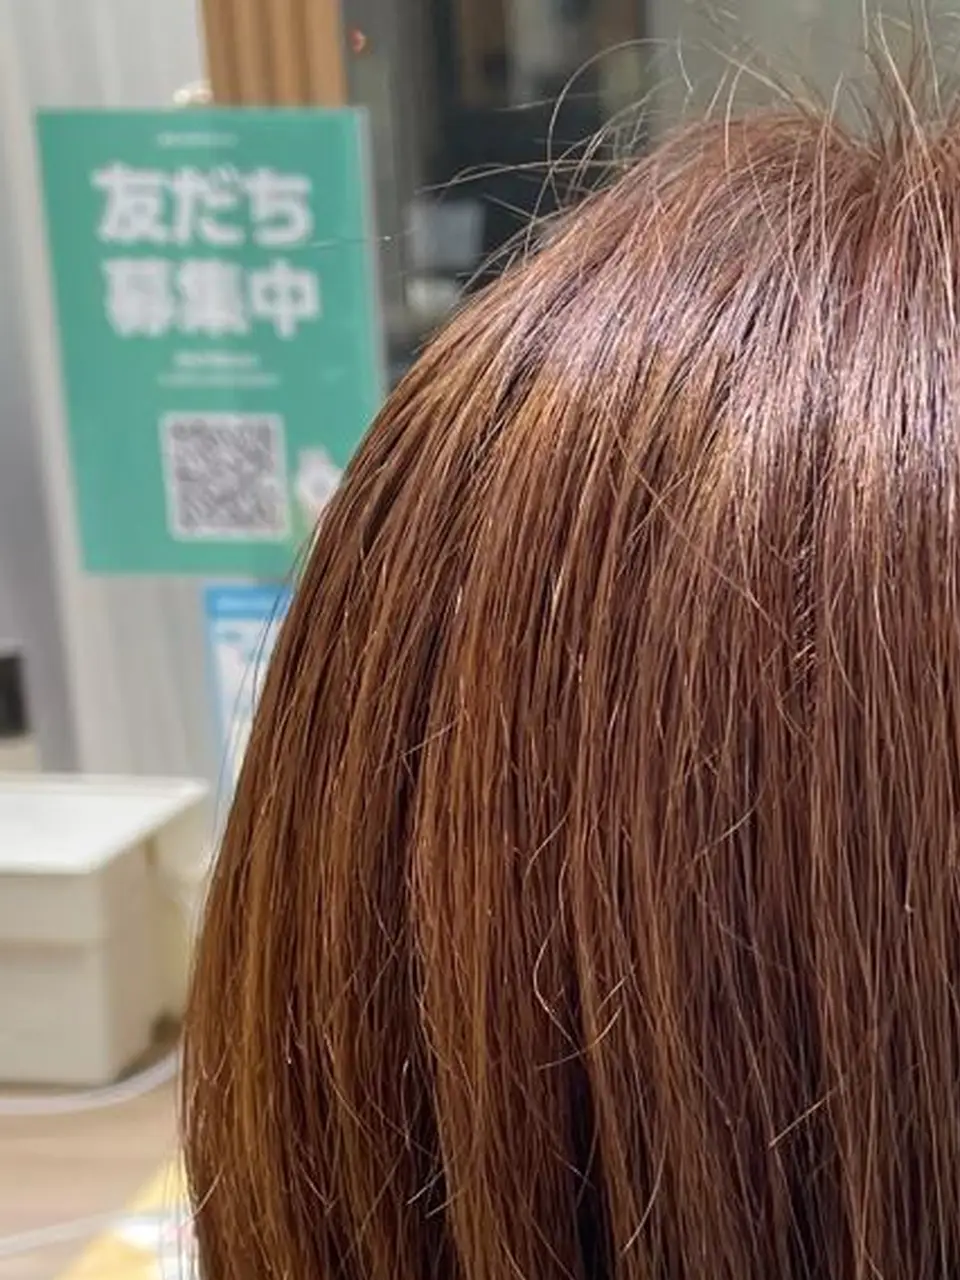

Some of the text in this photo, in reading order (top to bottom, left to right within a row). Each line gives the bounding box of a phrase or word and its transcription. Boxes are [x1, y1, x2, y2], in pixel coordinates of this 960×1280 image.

[92, 161, 313, 247] 友だち
[102, 257, 321, 338] 募集中
